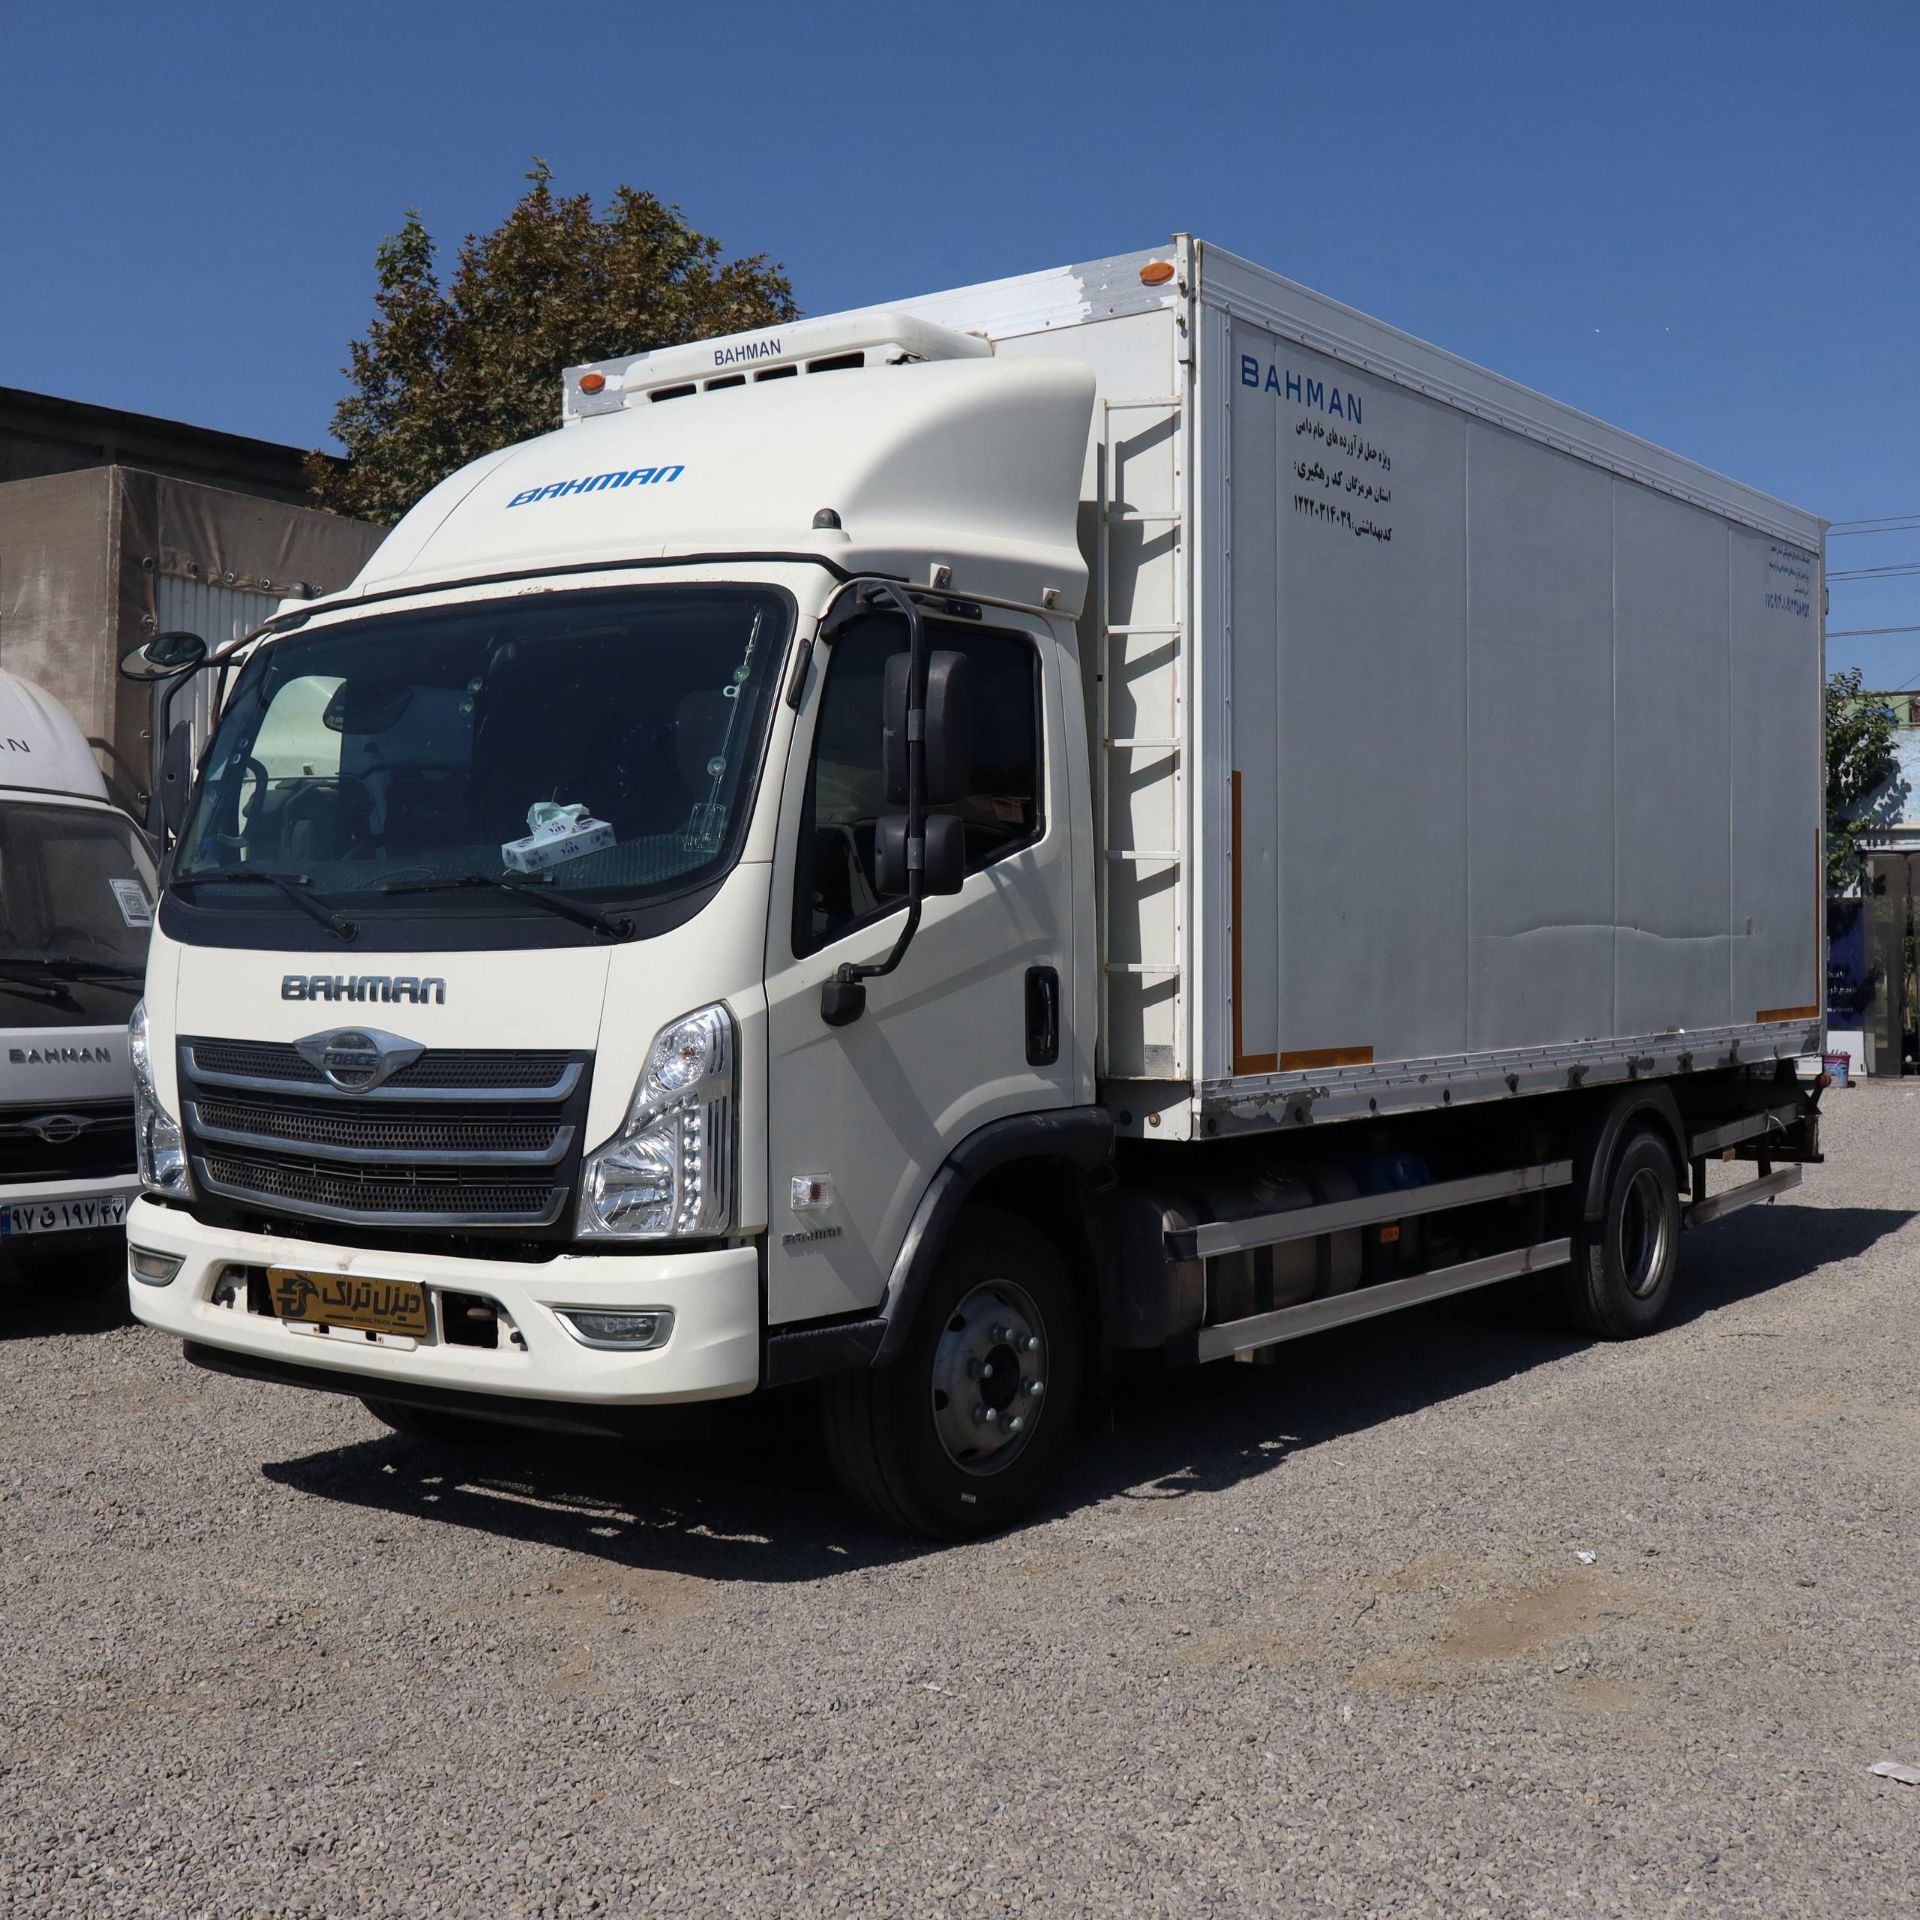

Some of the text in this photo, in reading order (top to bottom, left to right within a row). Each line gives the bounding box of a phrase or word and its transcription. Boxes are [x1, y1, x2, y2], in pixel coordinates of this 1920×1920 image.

[714, 339, 782, 366] BAHMAN
[1241, 354, 1362, 425] BAHMAN
[505, 465, 686, 509] BAHMAN
[0, 737, 31, 752] N
[281, 975, 447, 1005] BAHMAN
[8, 1047, 112, 1064] BAHMAN
[323, 1053, 378, 1066] FORCE
[322, 1281, 421, 1321] دیزل تراک
